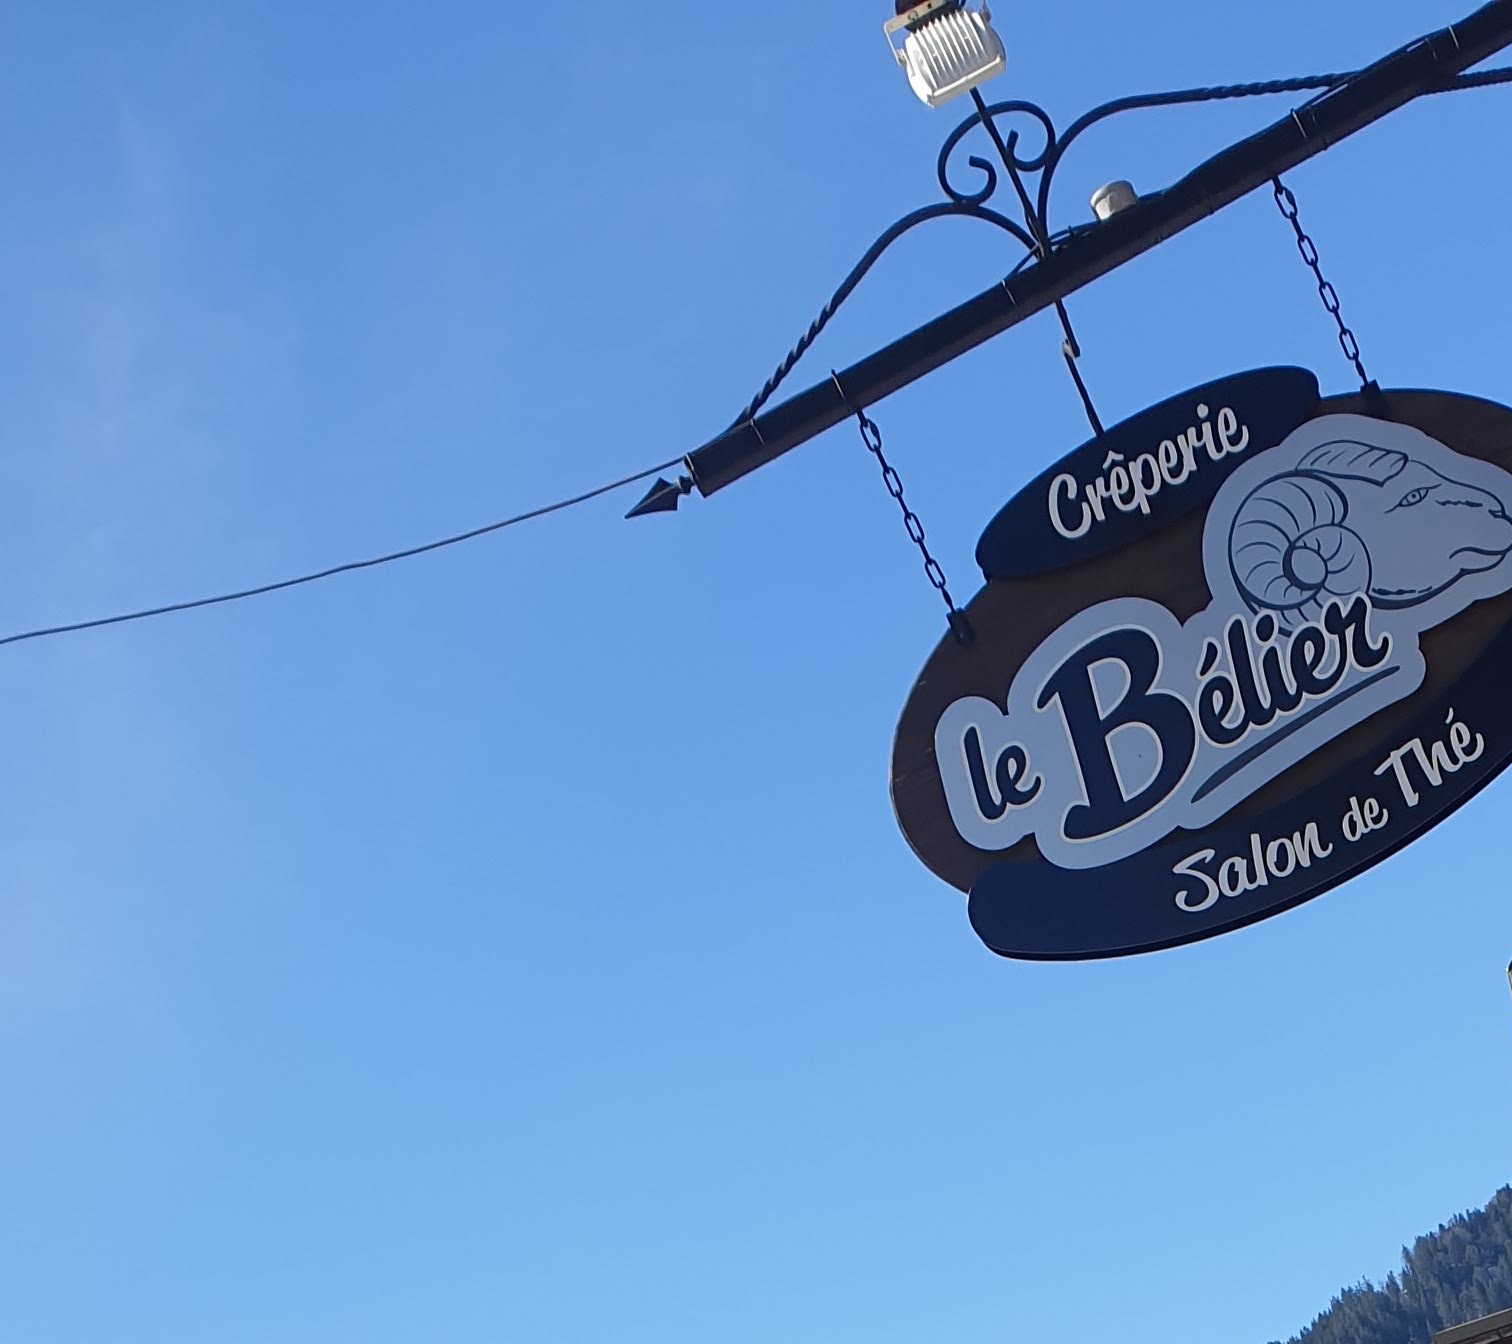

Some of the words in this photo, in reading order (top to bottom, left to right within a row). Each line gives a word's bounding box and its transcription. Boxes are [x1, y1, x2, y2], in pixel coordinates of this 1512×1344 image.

[1048, 403, 1249, 539] Crêperie
[962, 722, 1044, 824] le
[1034, 592, 1393, 845] Bélier
[1172, 821, 1334, 913] Salon
[1341, 796, 1389, 842] de
[1373, 706, 1486, 808] Thé
